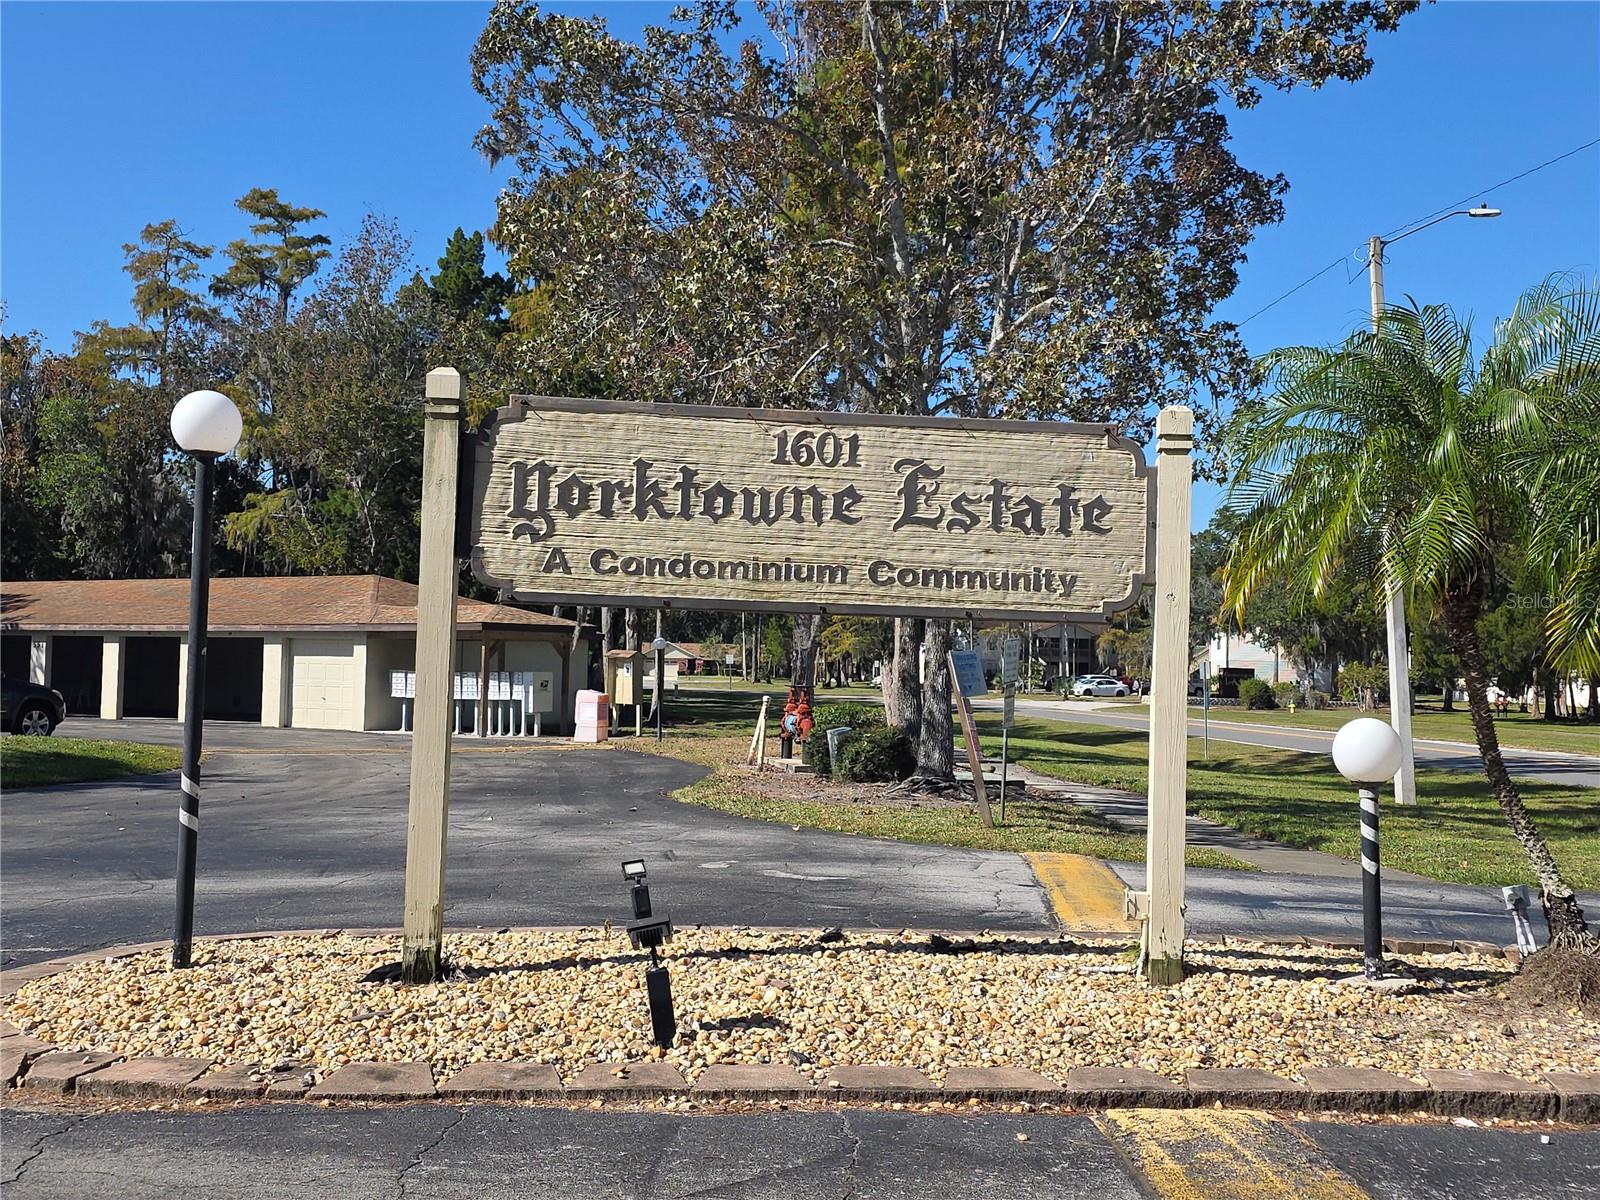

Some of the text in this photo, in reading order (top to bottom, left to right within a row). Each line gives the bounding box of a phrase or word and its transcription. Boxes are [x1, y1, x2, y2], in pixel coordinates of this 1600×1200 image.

[770, 429, 862, 468] 1601
[507, 457, 1114, 543] Yorktowne Estate
[541, 547, 1078, 598] A Condominium Community
